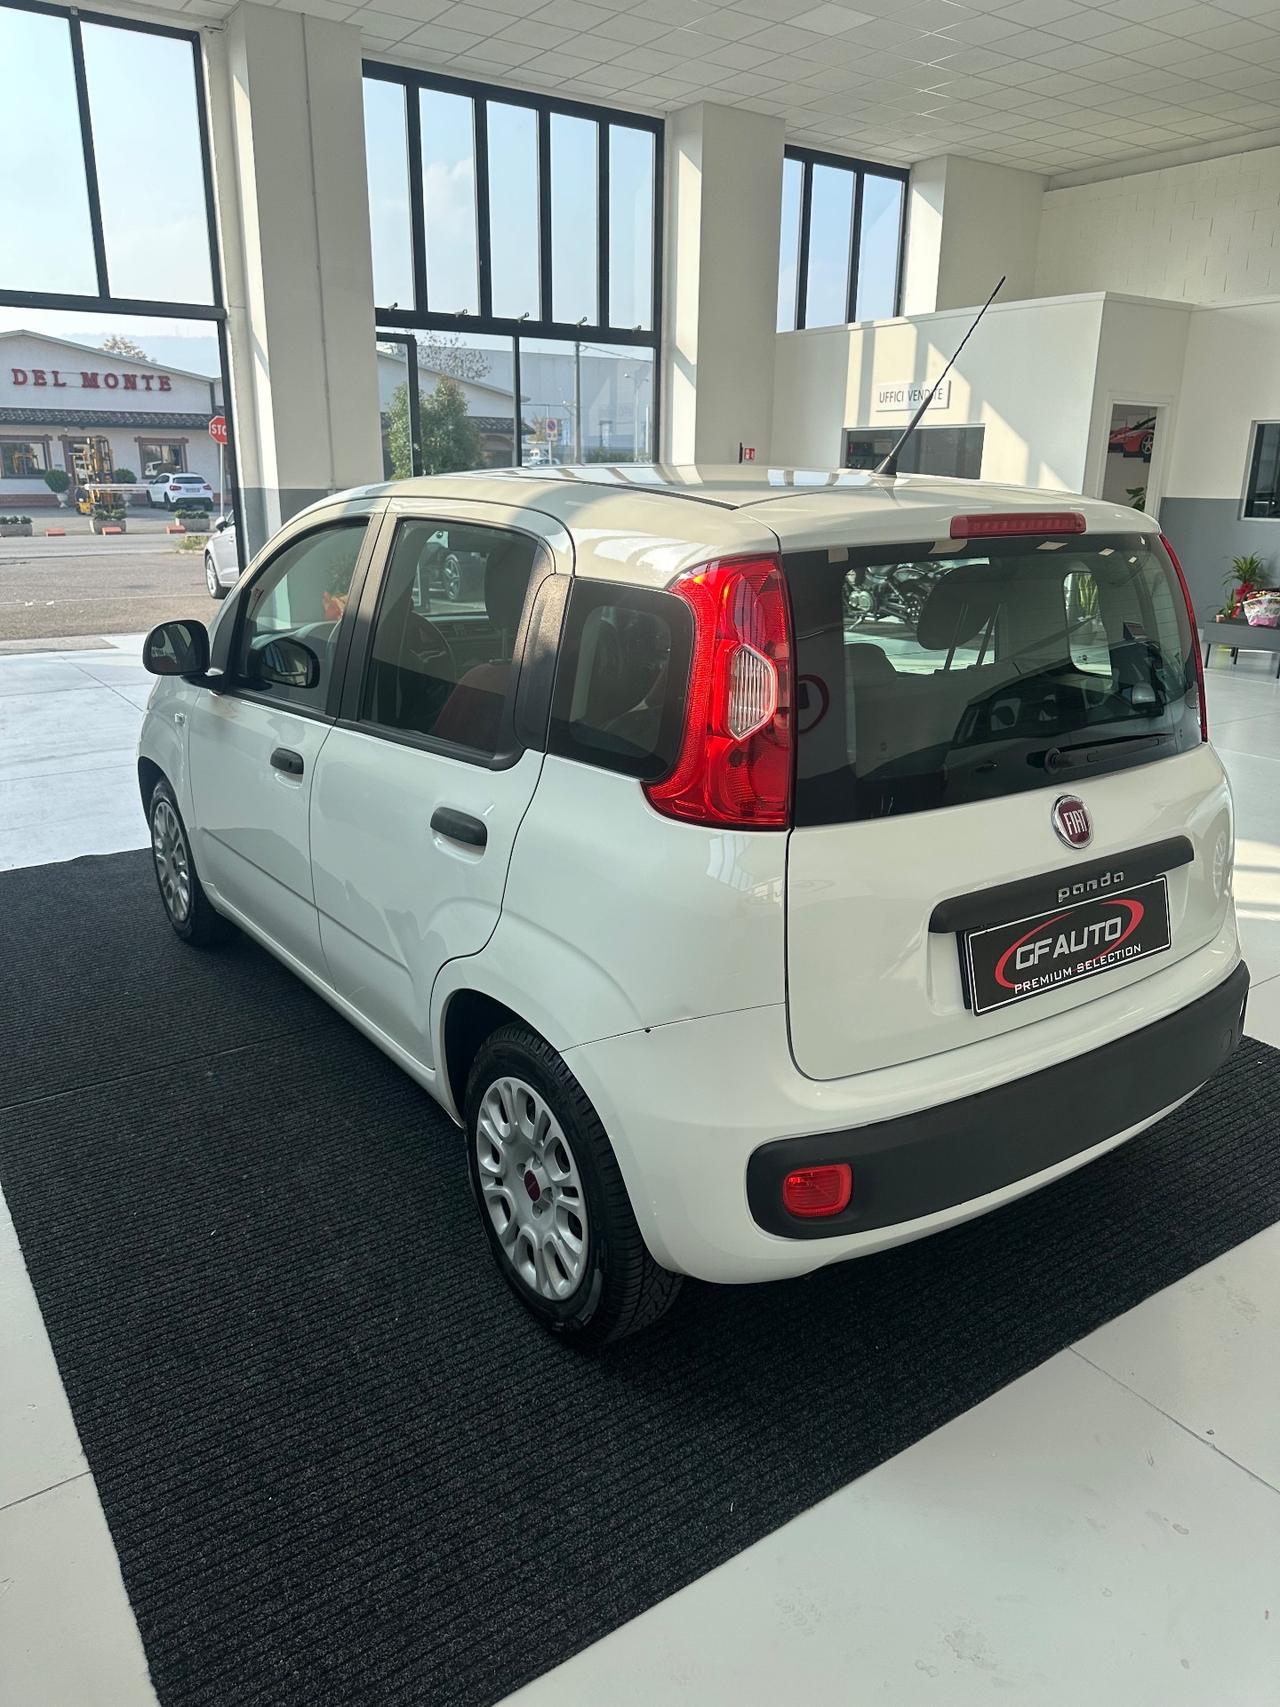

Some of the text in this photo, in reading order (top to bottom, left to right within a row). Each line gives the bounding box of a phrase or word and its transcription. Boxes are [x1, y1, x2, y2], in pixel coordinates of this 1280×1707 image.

[11, 368, 172, 392] DEL MONTE
[879, 388, 943, 404] UFFICI VENDTE
[1062, 808, 1088, 836] FIAT
[1056, 870, 1125, 903] panda
[1014, 943, 1142, 995] PREMIUM SELECTION
